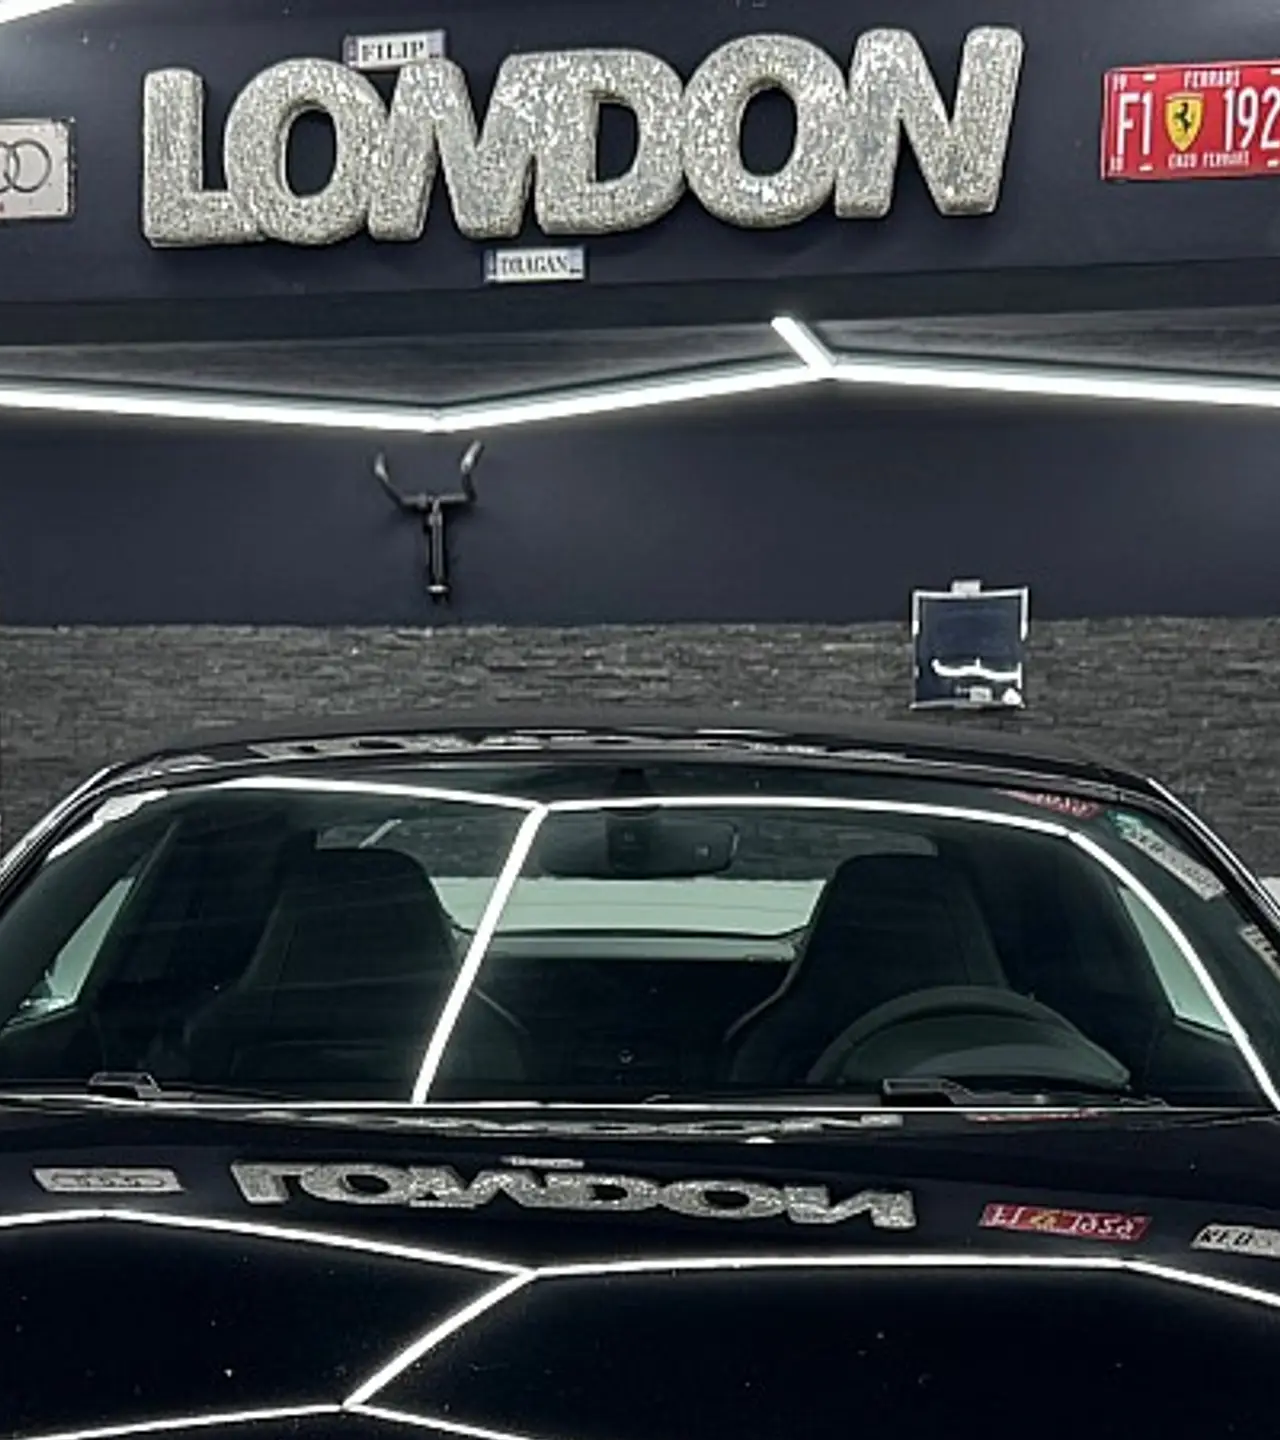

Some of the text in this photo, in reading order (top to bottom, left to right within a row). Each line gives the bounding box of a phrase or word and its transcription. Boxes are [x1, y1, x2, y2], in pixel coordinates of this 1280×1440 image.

[362, 41, 424, 61] FILIP
[1184, 70, 1240, 88] FERRARI
[144, 27, 1022, 247] LONDON
[1118, 92, 1152, 156] F1
